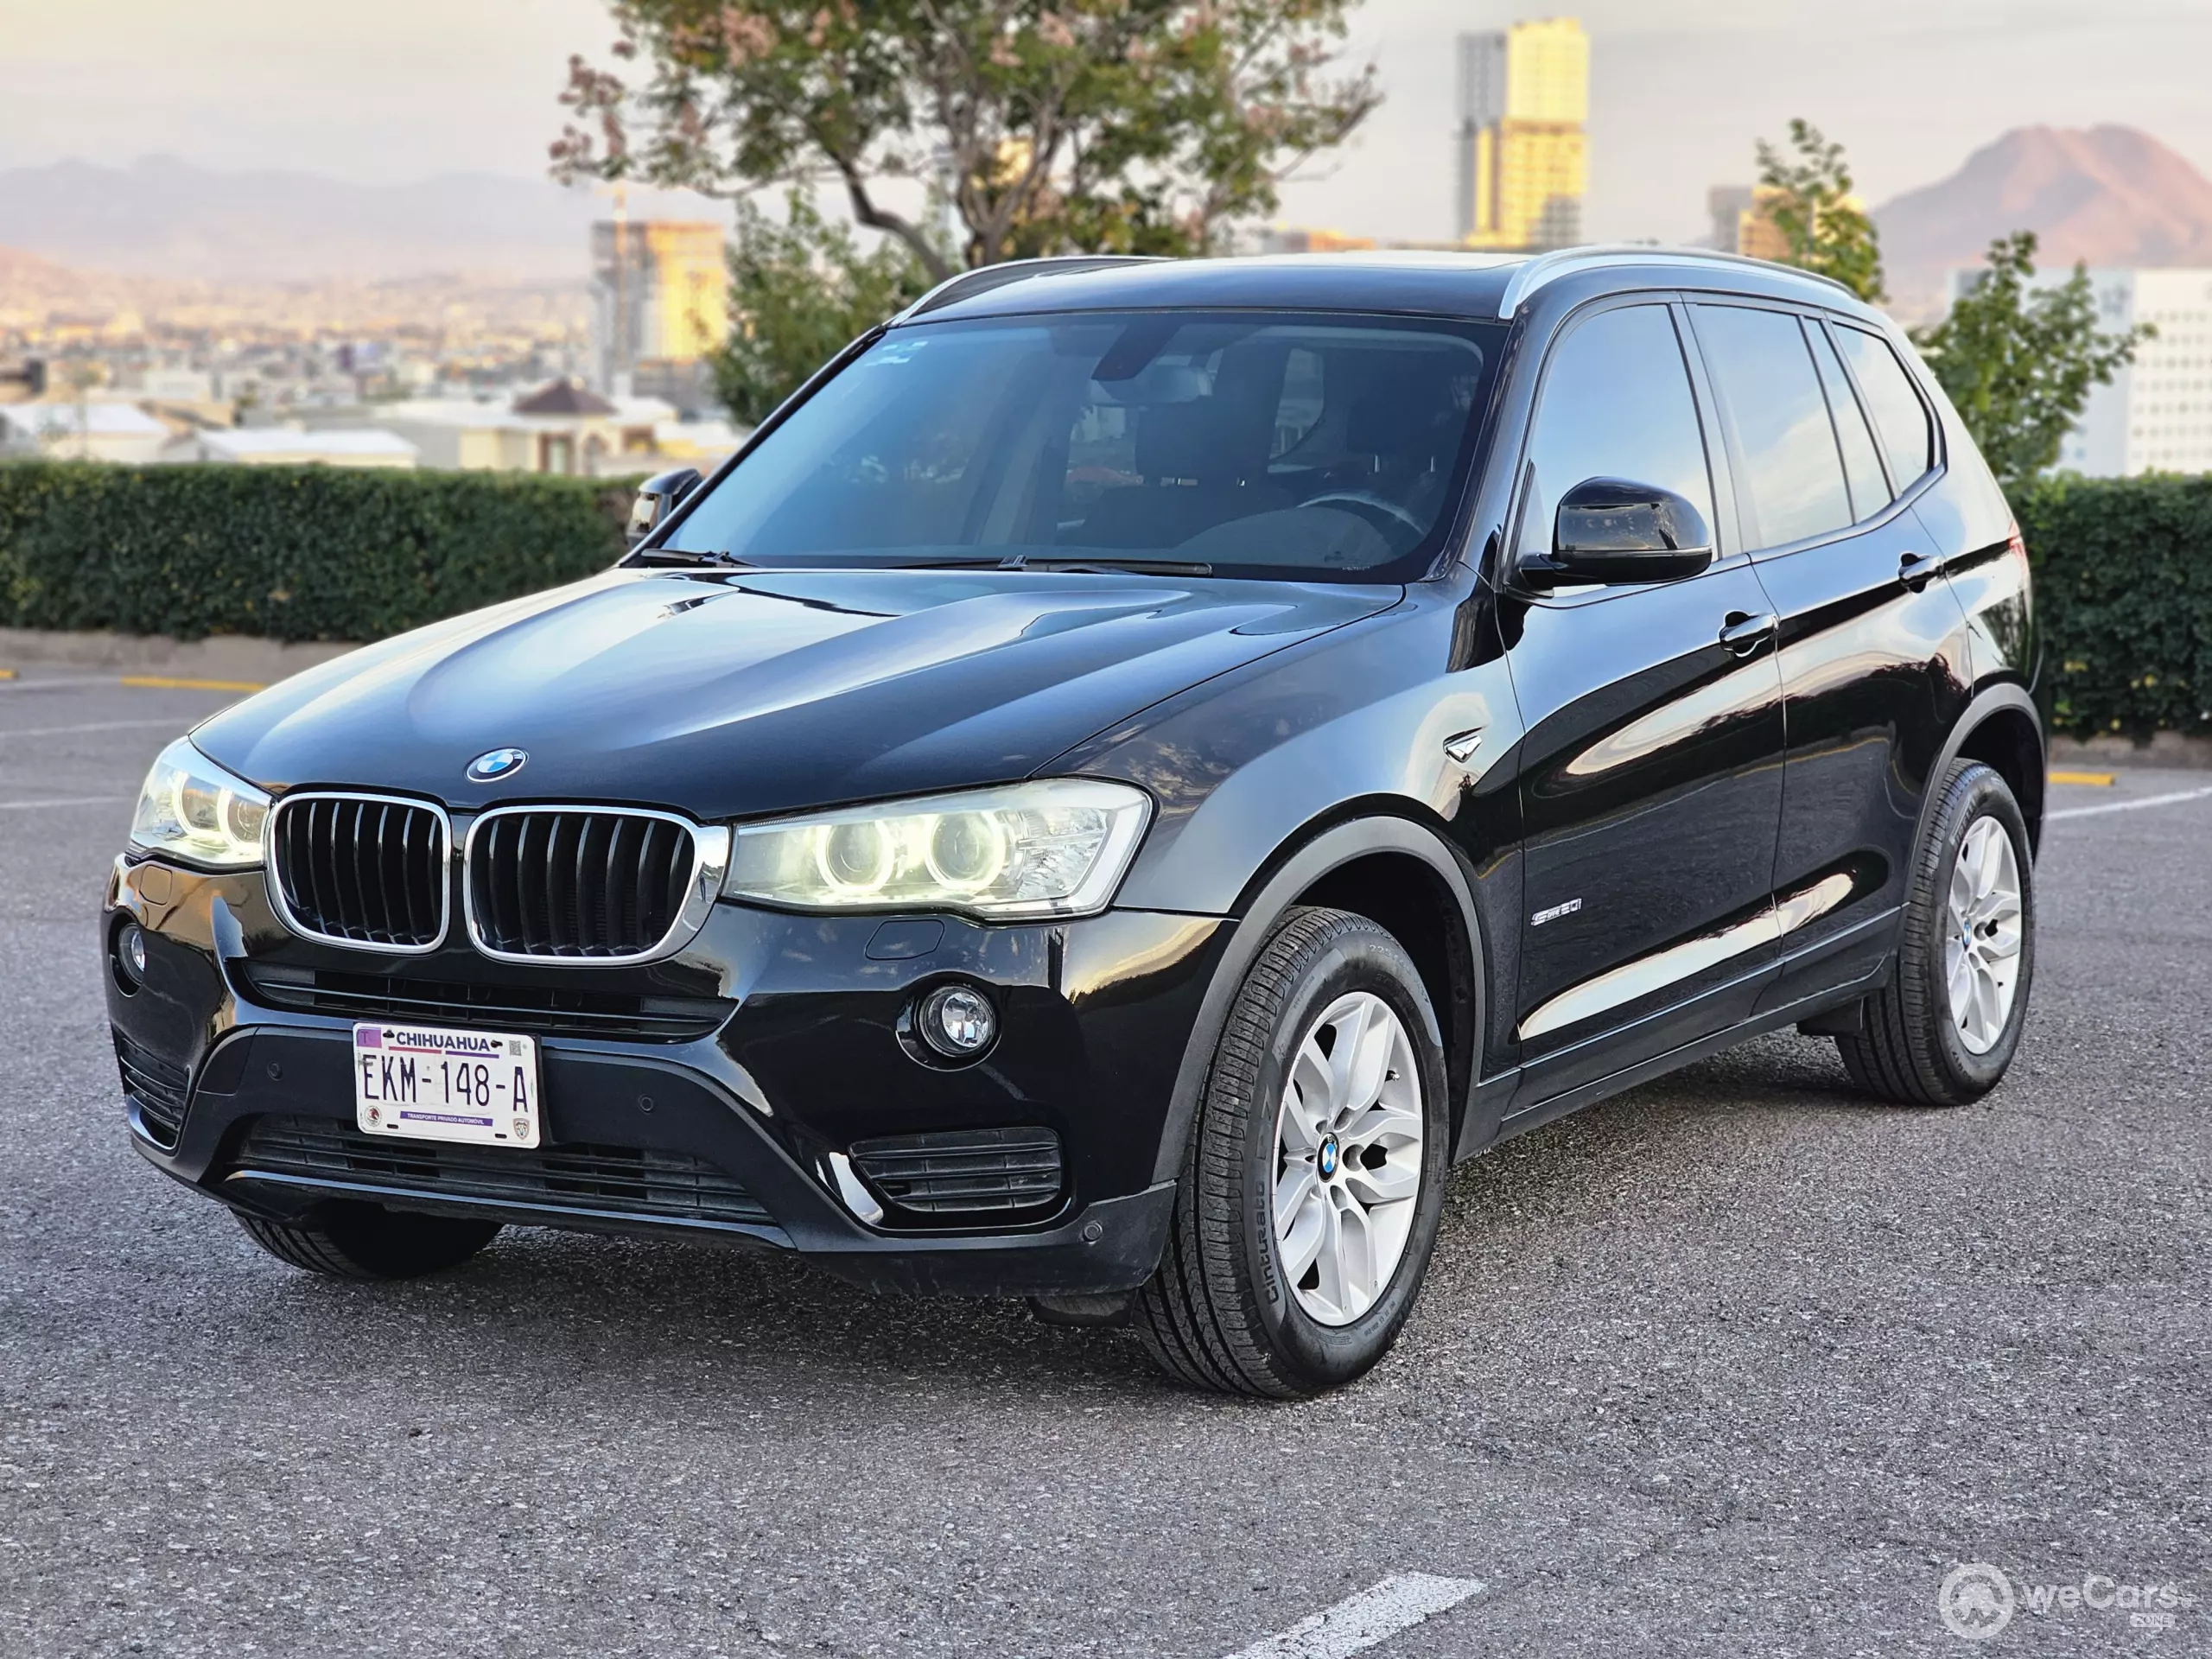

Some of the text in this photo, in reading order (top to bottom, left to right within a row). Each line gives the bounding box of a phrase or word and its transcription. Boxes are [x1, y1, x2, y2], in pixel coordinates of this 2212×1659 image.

[396, 1032, 490, 1052] CHIHUAHUA
[361, 1054, 529, 1113] EKM-148-A
[1255, 1180, 1280, 1306] Cinturato
